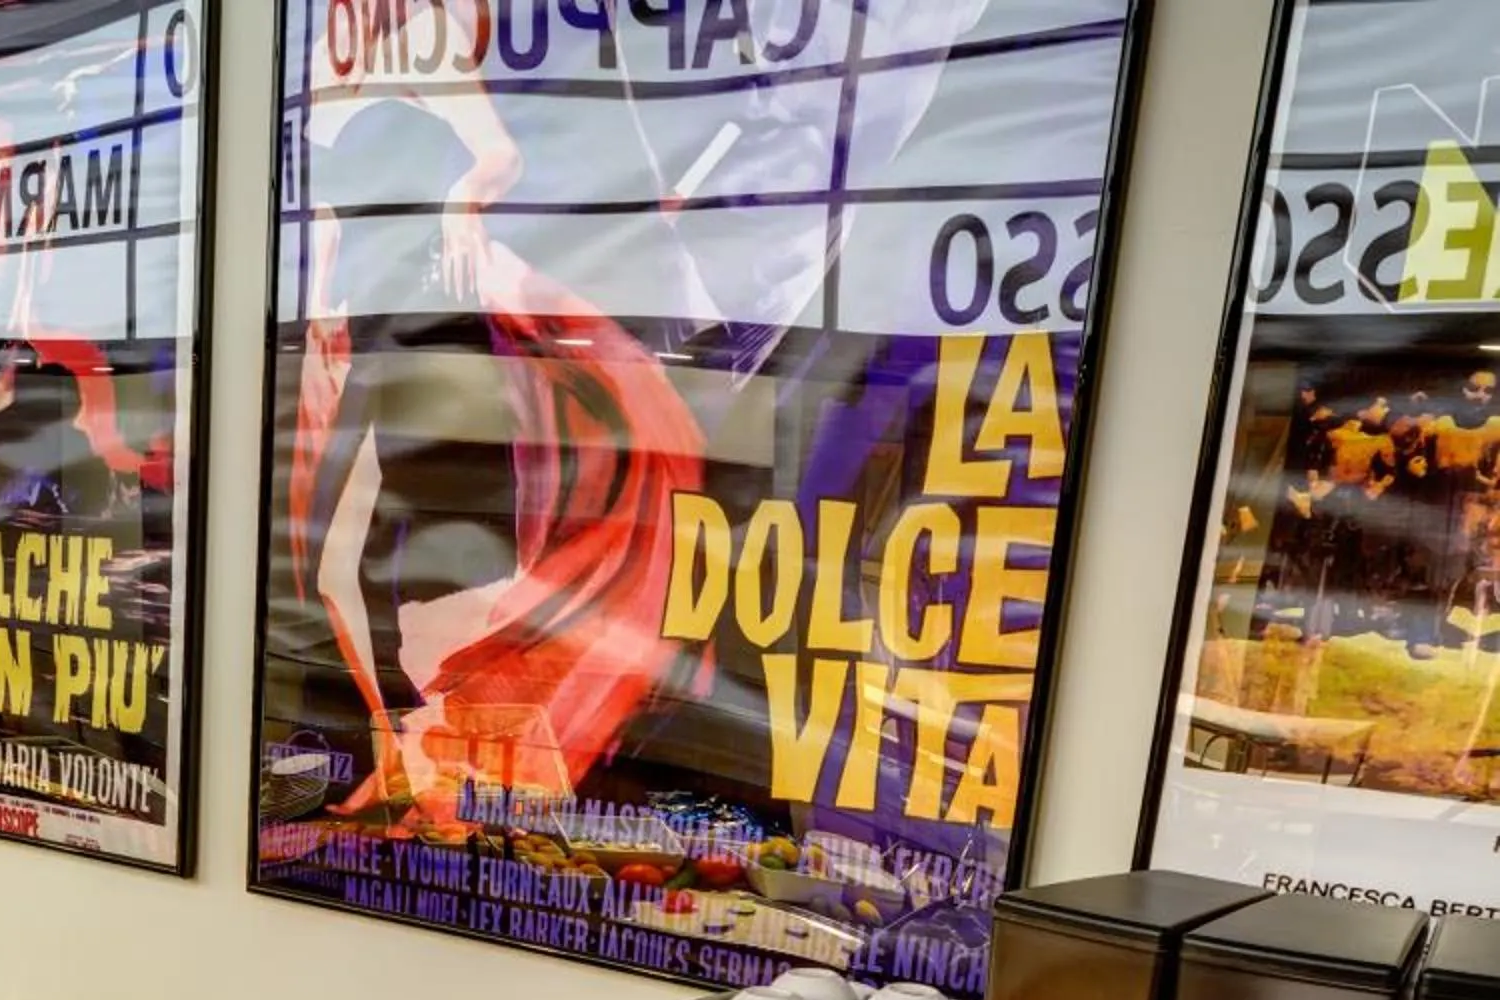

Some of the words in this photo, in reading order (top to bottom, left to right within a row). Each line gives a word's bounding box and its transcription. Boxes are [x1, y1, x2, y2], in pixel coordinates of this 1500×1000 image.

[923, 329, 1065, 497] LA
[661, 492, 1057, 669] DOLCE
[761, 653, 1035, 829] VITA
[457, 781, 577, 839] MARCELLO
[391, 843, 472, 892] YVONNE
[477, 857, 591, 916] FURNEAUX
[1263, 872, 1416, 909] FRANCESCA
